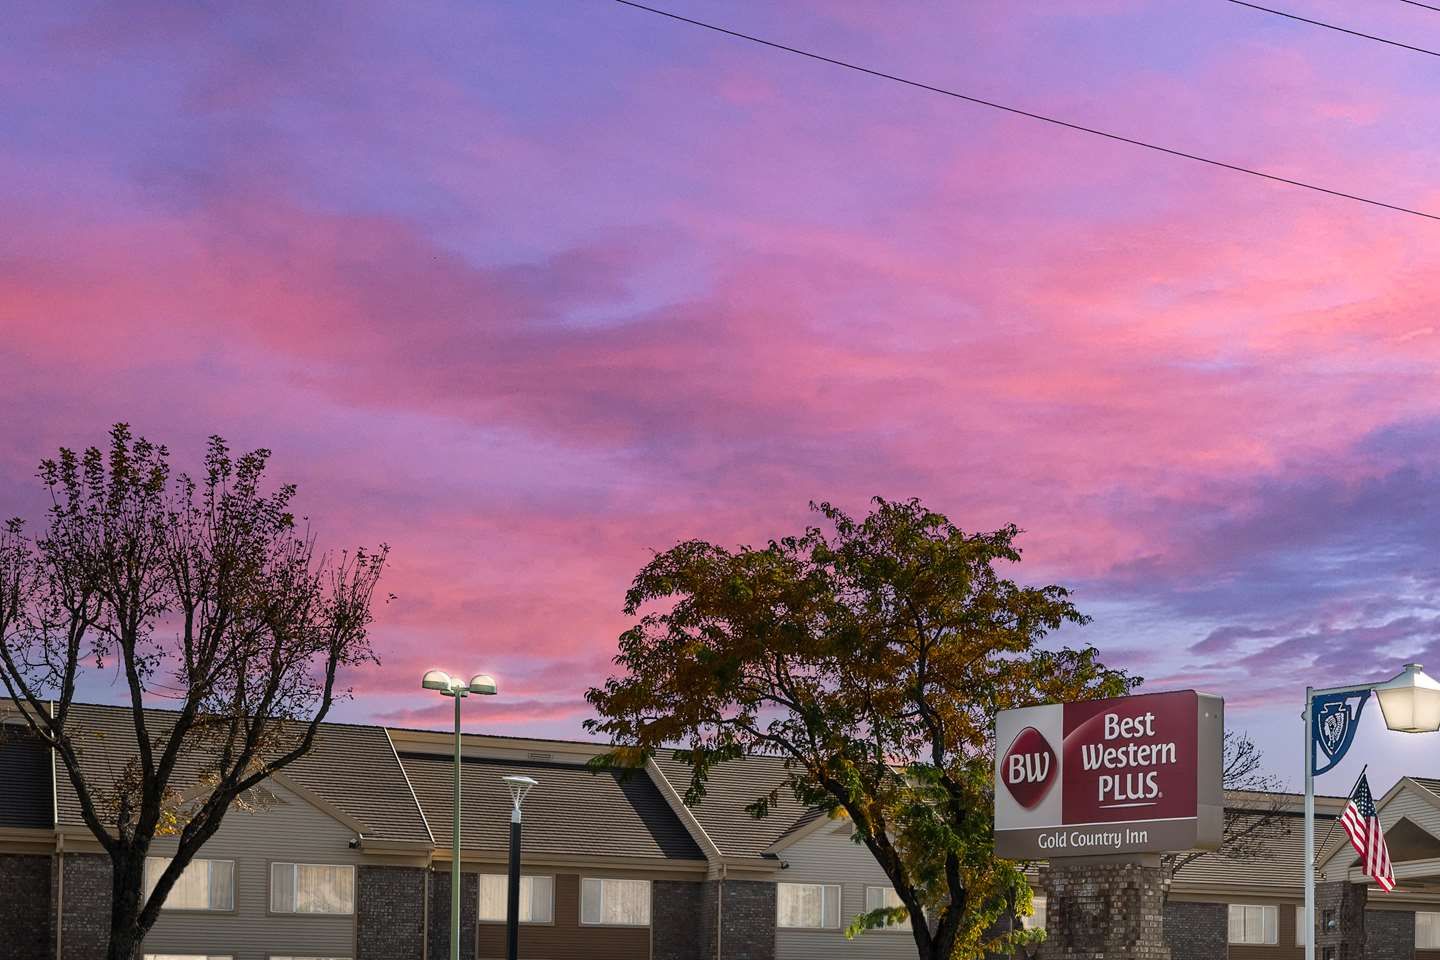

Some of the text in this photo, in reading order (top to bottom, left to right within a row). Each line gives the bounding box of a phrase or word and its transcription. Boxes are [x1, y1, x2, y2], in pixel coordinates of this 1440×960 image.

[1104, 712, 1156, 741] Best
[1009, 752, 1050, 784] BW
[1081, 742, 1177, 771] Western
[1038, 829, 1148, 849] Gold Country Inn
